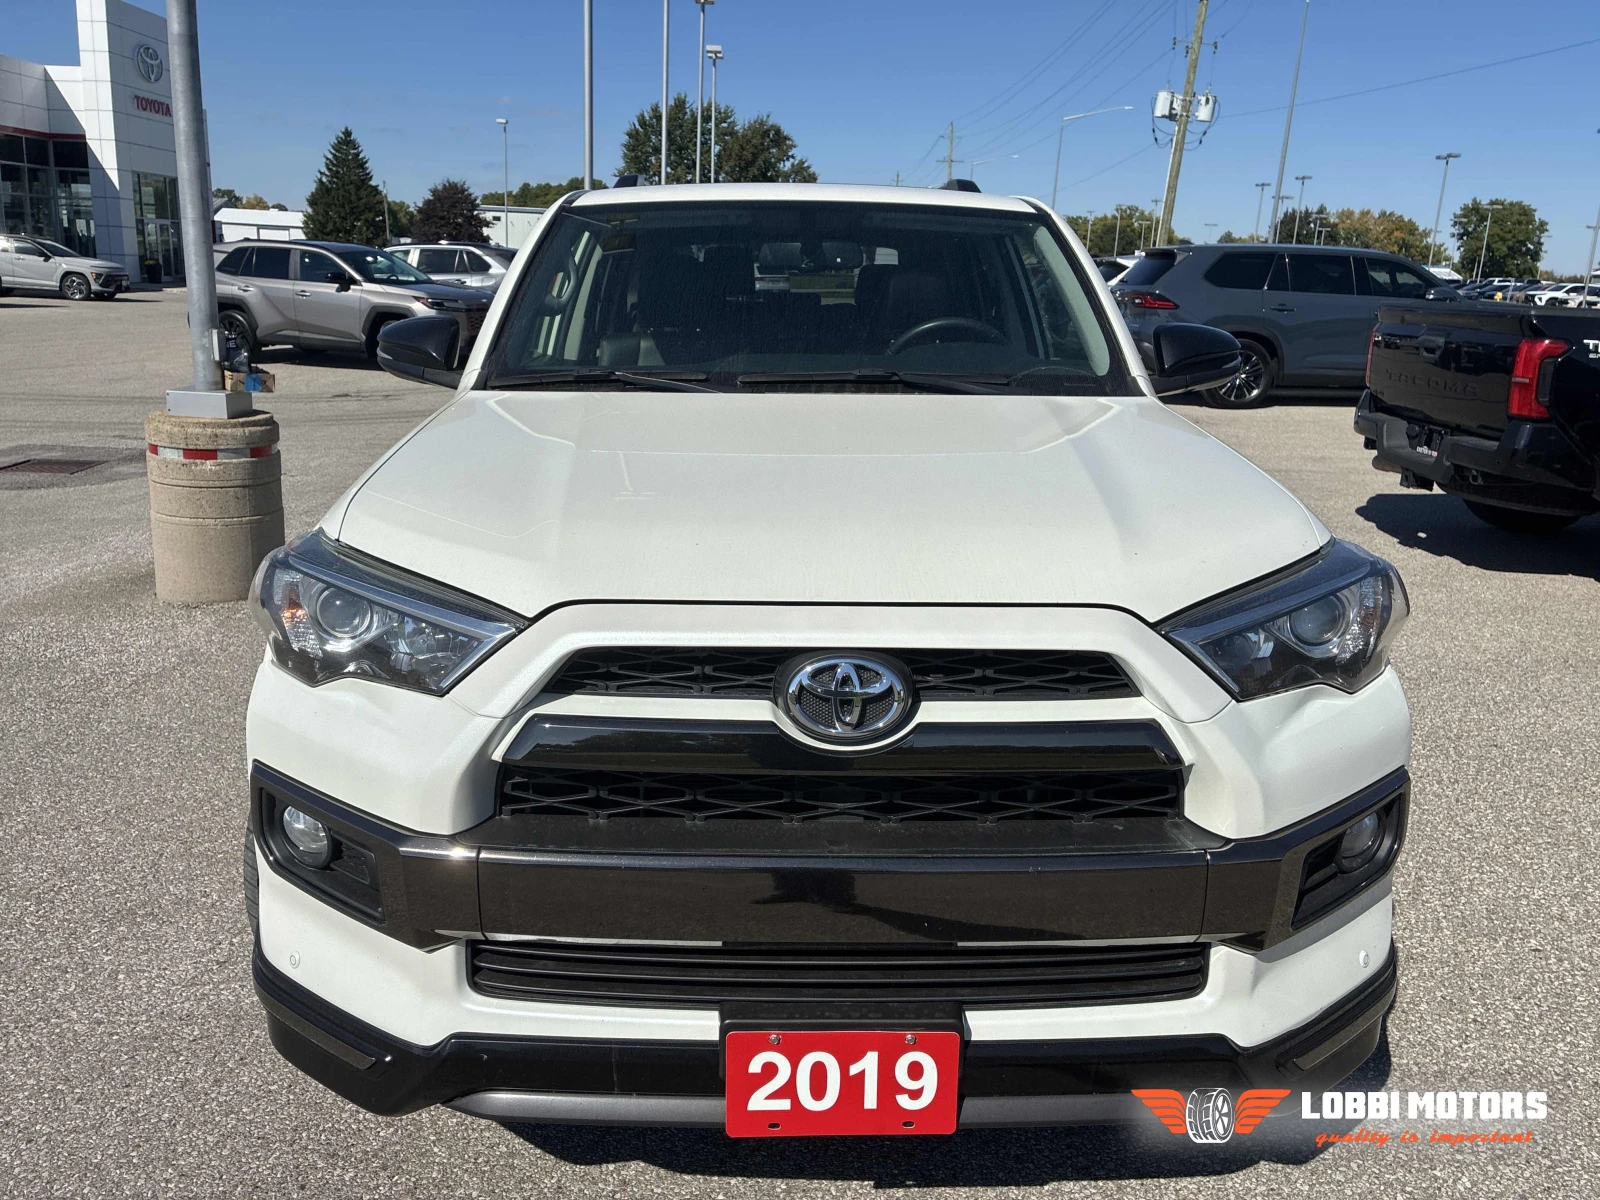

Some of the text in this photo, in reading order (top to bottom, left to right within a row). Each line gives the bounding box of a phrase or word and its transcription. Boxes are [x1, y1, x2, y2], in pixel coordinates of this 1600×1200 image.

[134, 94, 172, 117] TOYOTA
[1583, 339, 1600, 353] T
[1386, 369, 1479, 397] TACOMA
[747, 1051, 938, 1111] 2019
